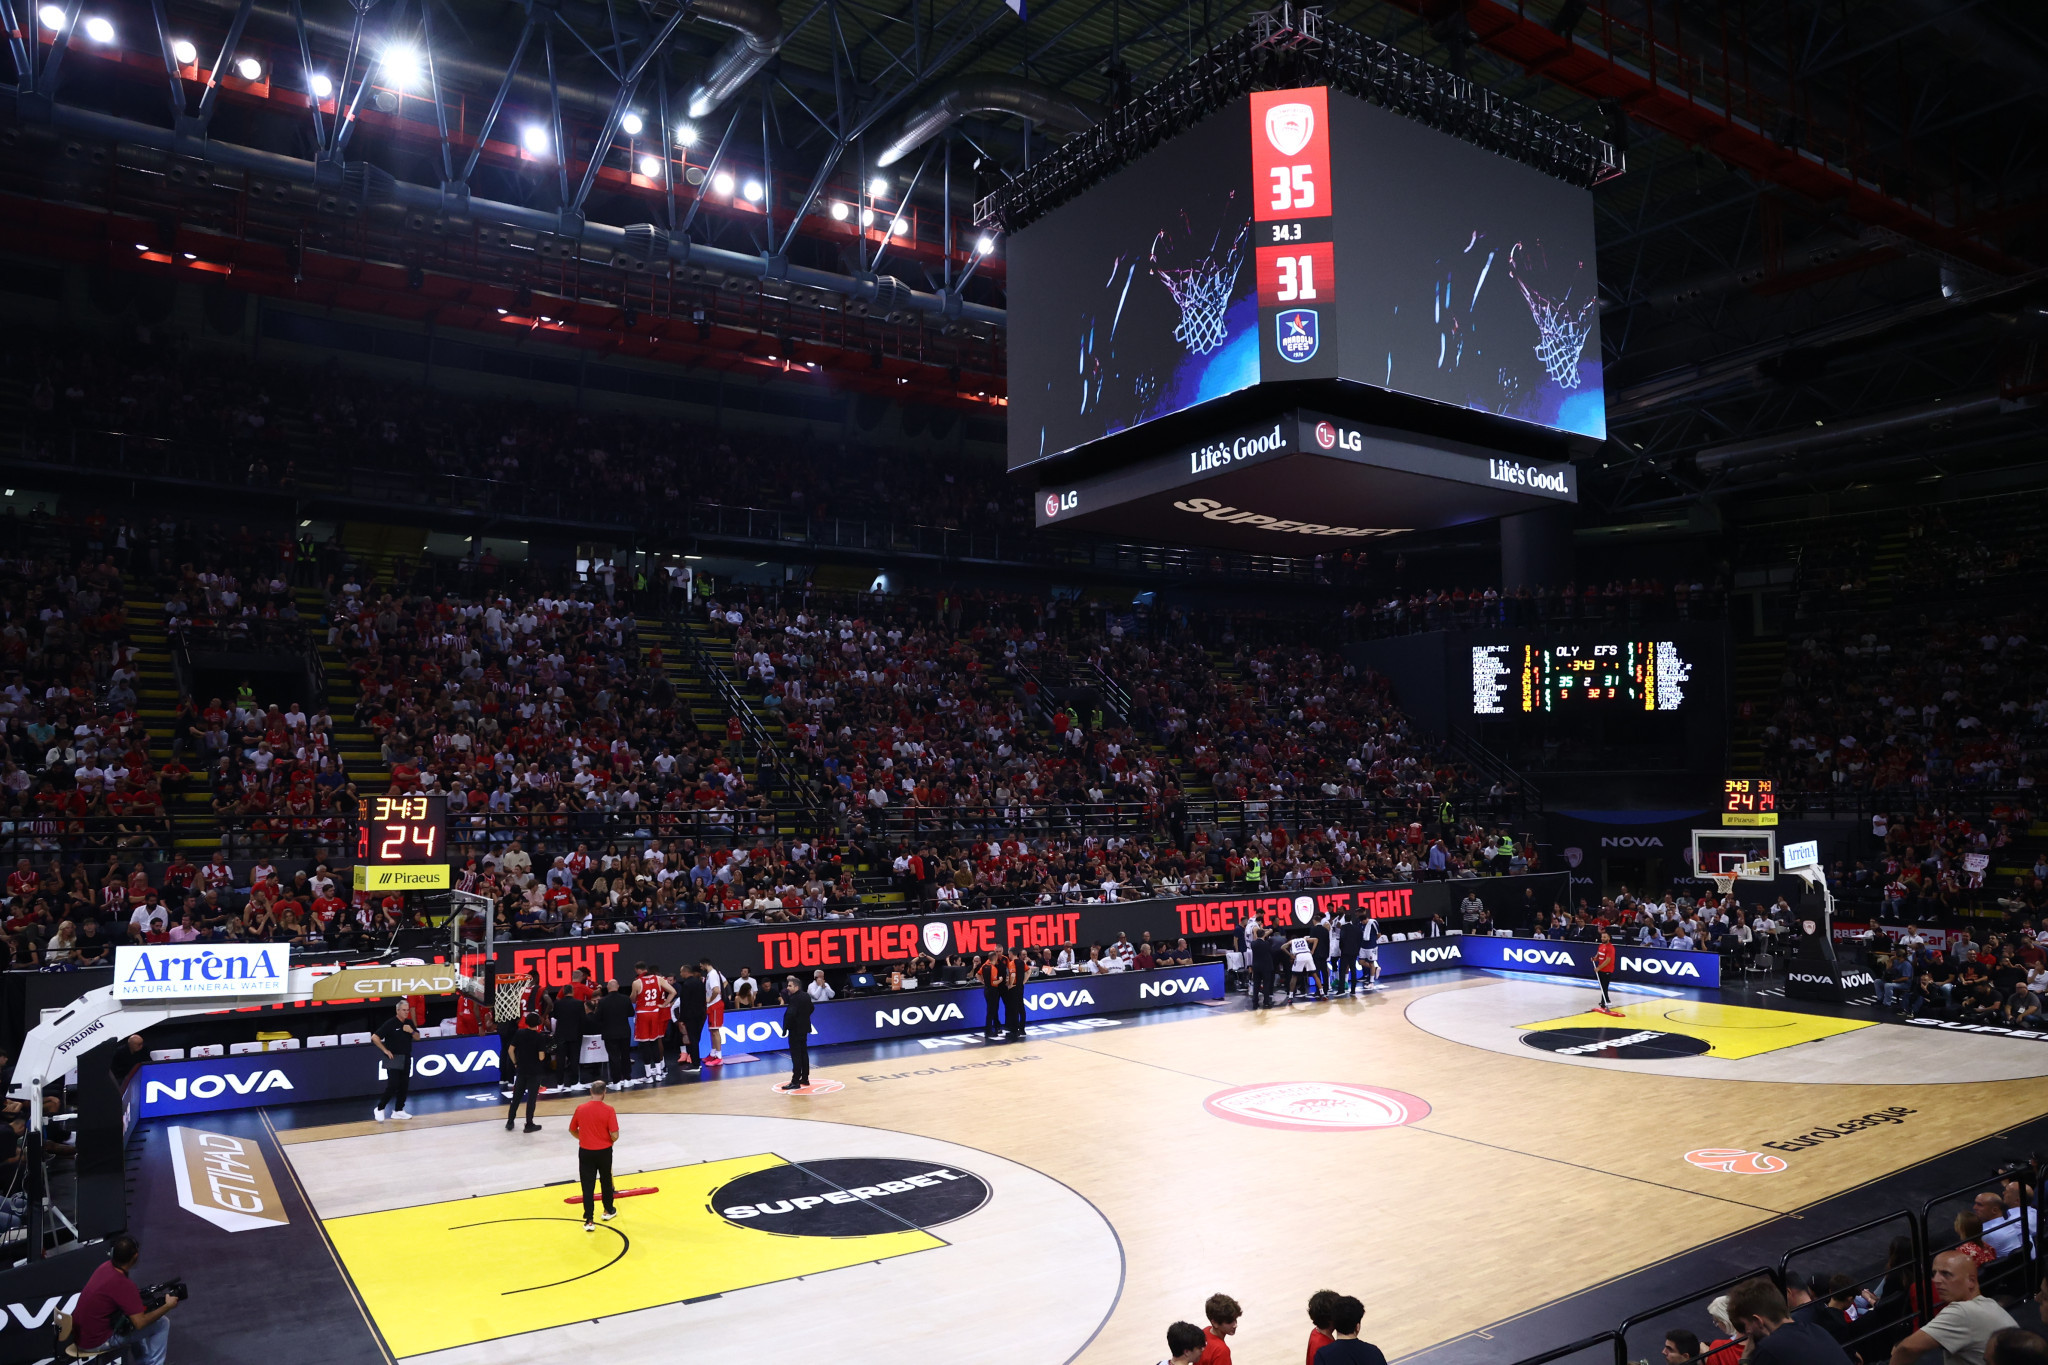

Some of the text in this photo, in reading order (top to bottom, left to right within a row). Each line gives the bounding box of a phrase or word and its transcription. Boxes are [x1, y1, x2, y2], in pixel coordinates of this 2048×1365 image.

[1270, 164, 1315, 210] 35
[1272, 224, 1302, 241] 34.3
[1276, 255, 1317, 301] 31
[1282, 335, 1314, 347] ANADOLU
[1287, 342, 1310, 352] EFES
[1191, 424, 1287, 475] Life's Good.
[1338, 428, 1362, 452] LG
[1489, 458, 1569, 494] Life's Good.
[1061, 490, 1078, 511] LG
[1173, 498, 1416, 537] SUPERBET
[1556, 644, 1618, 657] OLY EFS
[1559, 675, 1619, 687] 35 2 31
[1561, 689, 1568, 699] 5
[1608, 688, 1615, 698] 3
[1728, 793, 1753, 811] 24
[1760, 794, 1774, 810] 24
[381, 825, 436, 859] 24
[1601, 837, 1664, 847] NOVA
[394, 872, 440, 883] Piraeus
[757, 912, 1080, 970] TOGETHER WE FIGHT
[1411, 945, 1462, 964] NOVA
[1503, 947, 1575, 967] NOVA
[1620, 956, 1700, 978] NOVA
[123, 980, 279, 994] NATURAL MINERAL WATER
[353, 977, 454, 994] ETIHAD
[1140, 976, 1210, 1000] NOVA
[1789, 972, 1833, 985] NOVA
[1841, 972, 1875, 989] NOVA
[644, 988, 658, 1001] 33
[875, 1002, 964, 1029] NOVA
[57, 1019, 105, 1055] SPALDING
[1905, 1018, 2048, 1040] SUPE
[1555, 1030, 1667, 1056] SUPERBET
[856, 1053, 1044, 1083] EuroLeague
[145, 1069, 294, 1104] NOVA
[1762, 1106, 1918, 1152] EuroLeague
[198, 1133, 264, 1213] ETIHAD
[723, 1168, 958, 1220] SUPERBET
